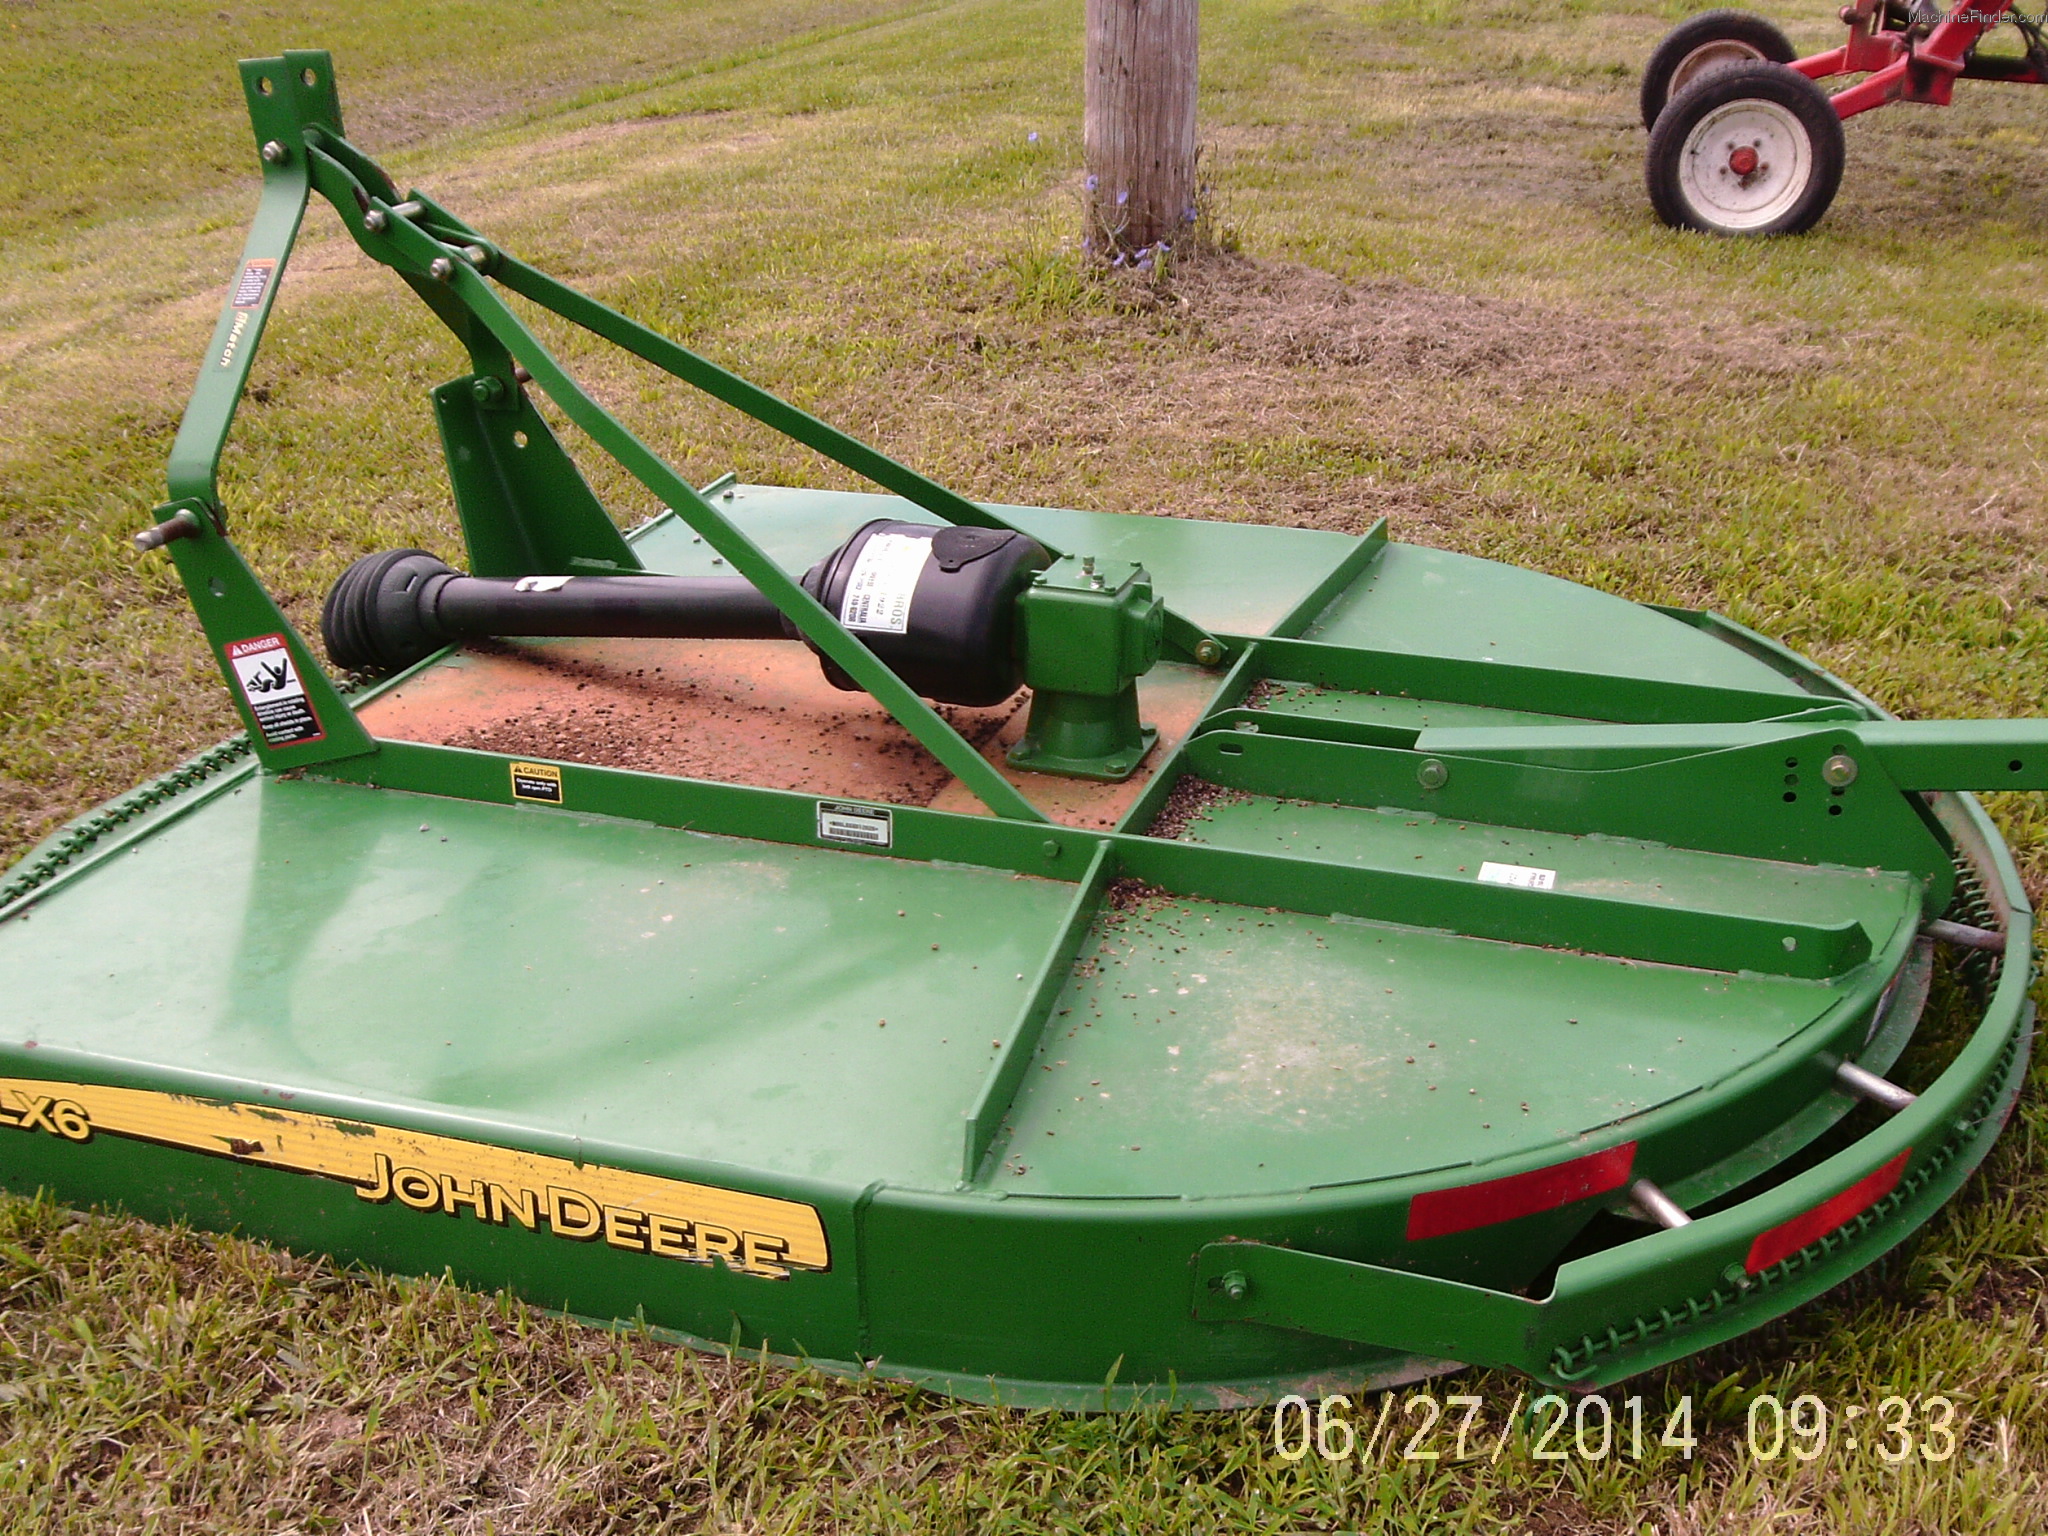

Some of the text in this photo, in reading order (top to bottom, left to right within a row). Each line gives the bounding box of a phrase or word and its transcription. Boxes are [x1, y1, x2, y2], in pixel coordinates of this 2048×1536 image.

[242, 637, 280, 654] DANGER
[523, 766, 558, 778] CAUTION
[355, 1153, 791, 1281] JOHN DEERE
